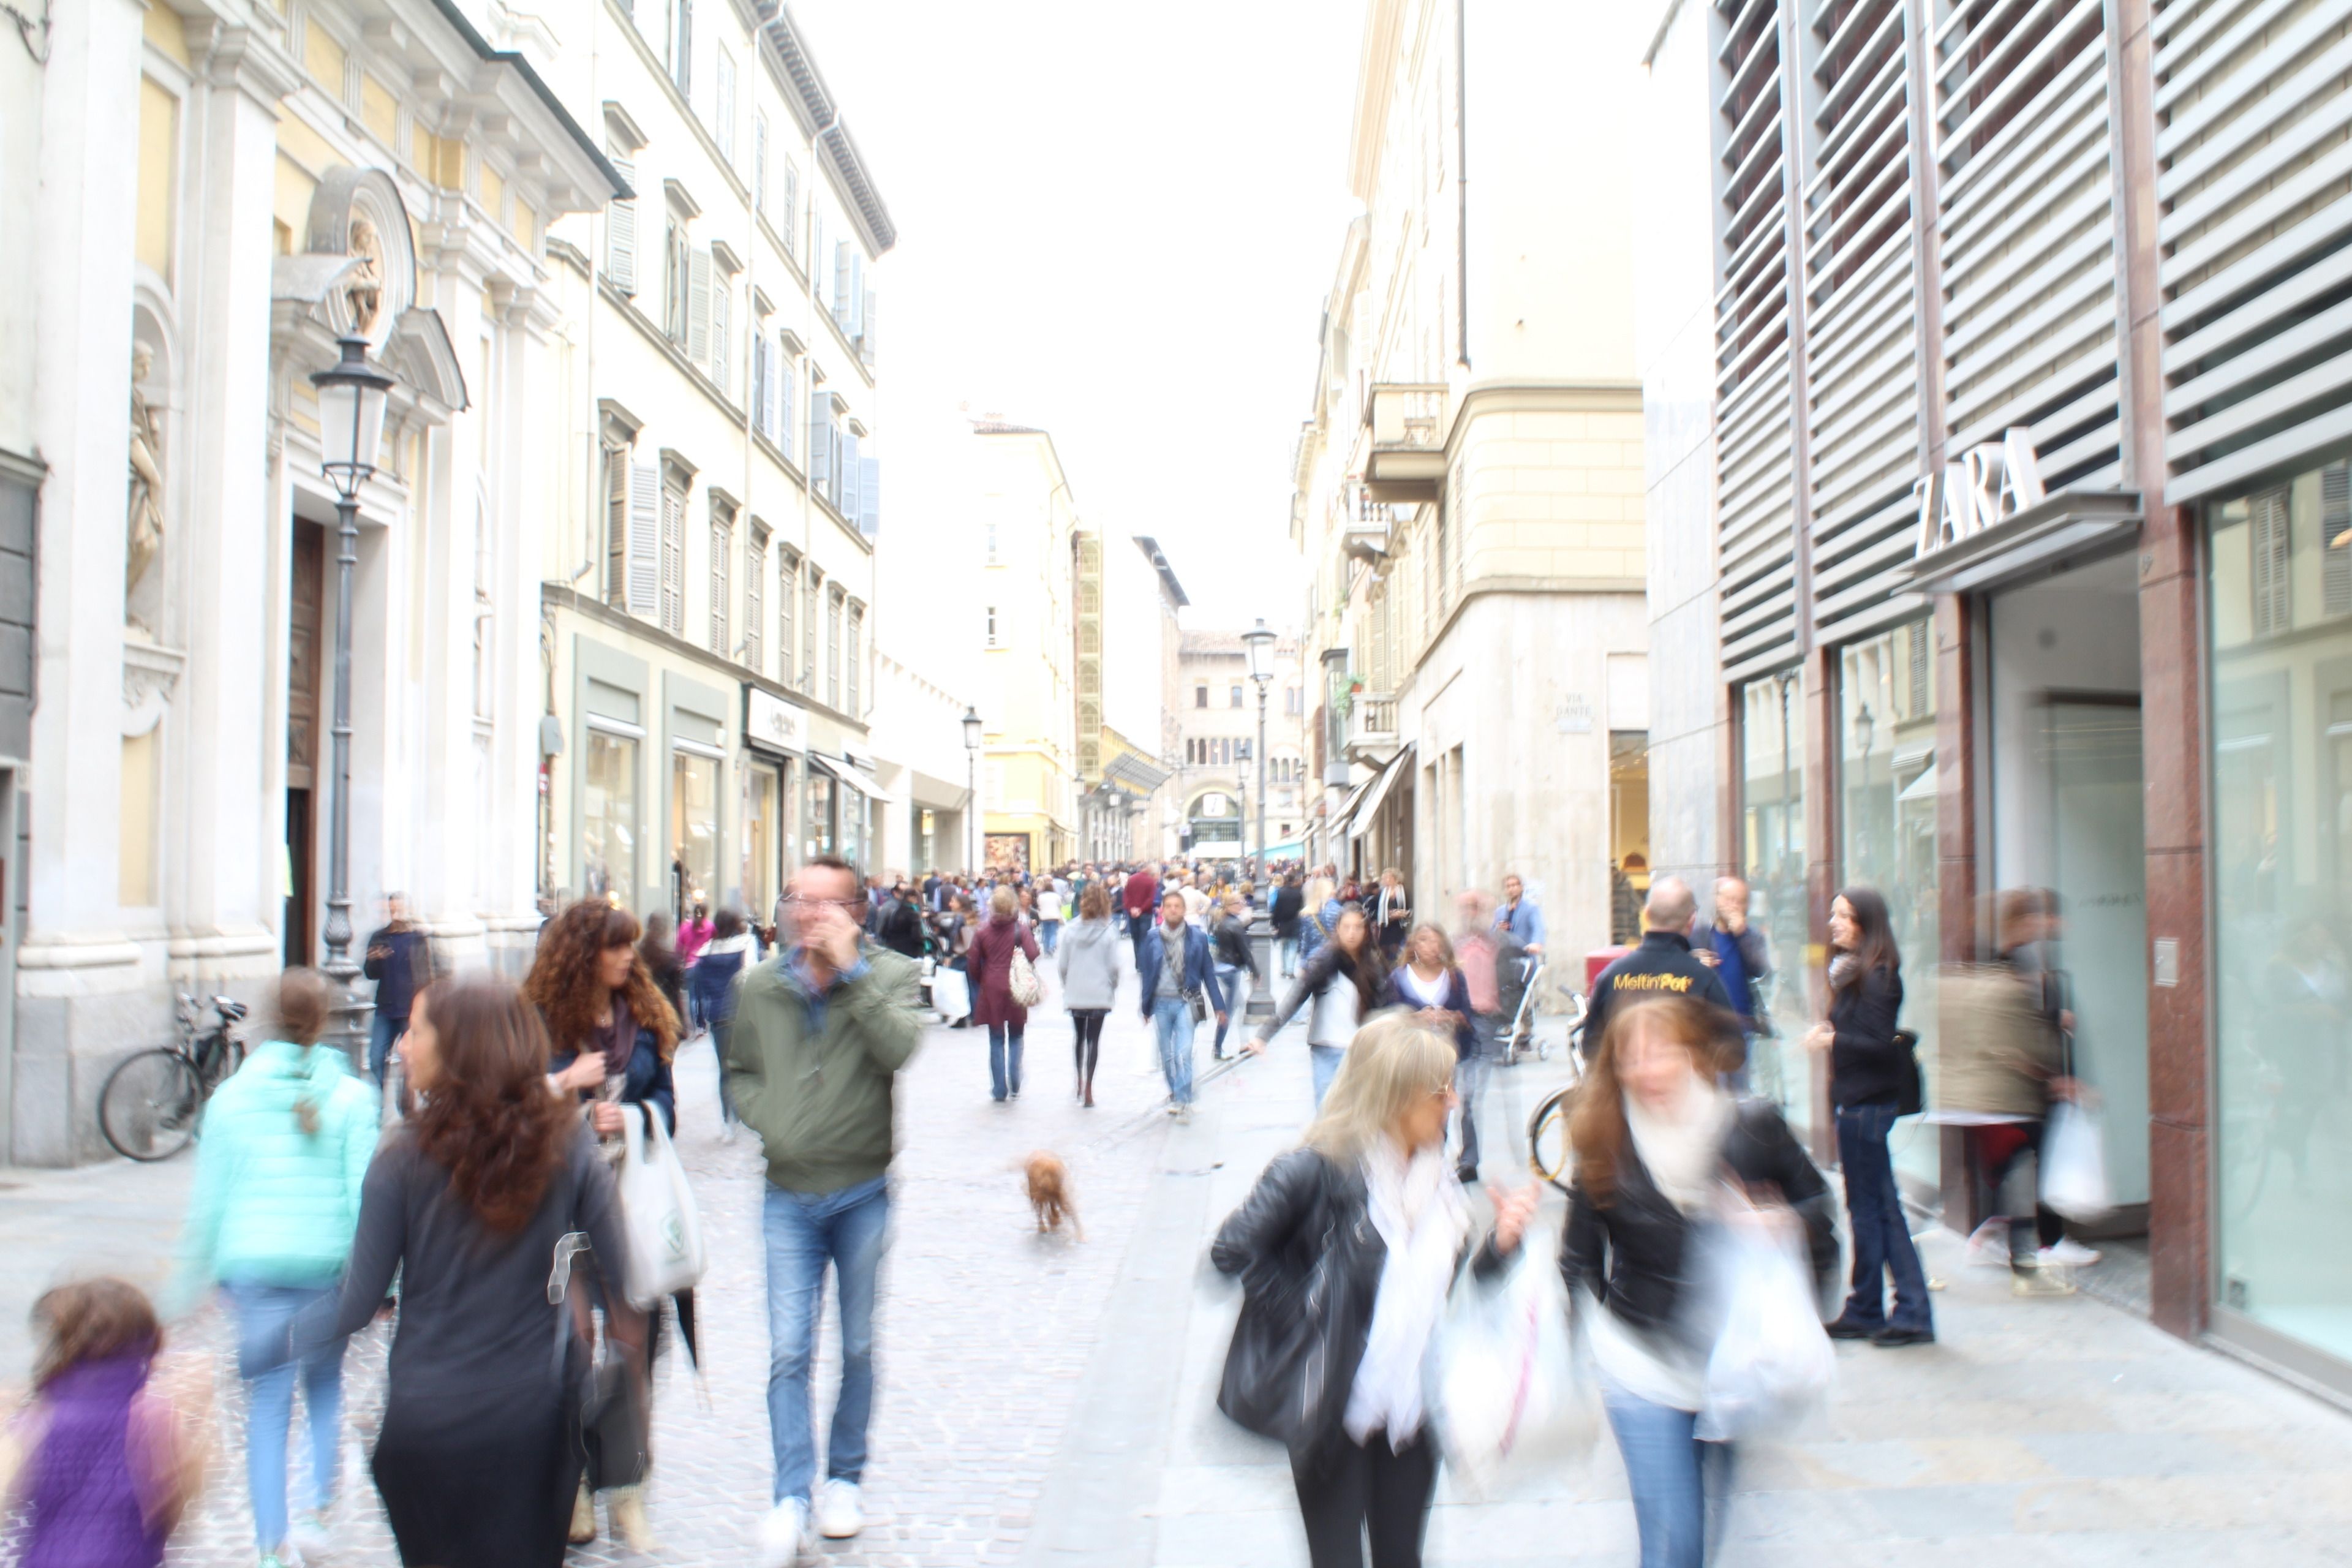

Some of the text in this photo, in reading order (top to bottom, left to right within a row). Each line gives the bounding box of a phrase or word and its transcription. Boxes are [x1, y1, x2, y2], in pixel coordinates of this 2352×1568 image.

[1912, 426, 2041, 559] ZARA
[1565, 692, 1583, 703] VIA
[1556, 705, 1591, 716] DANTE
